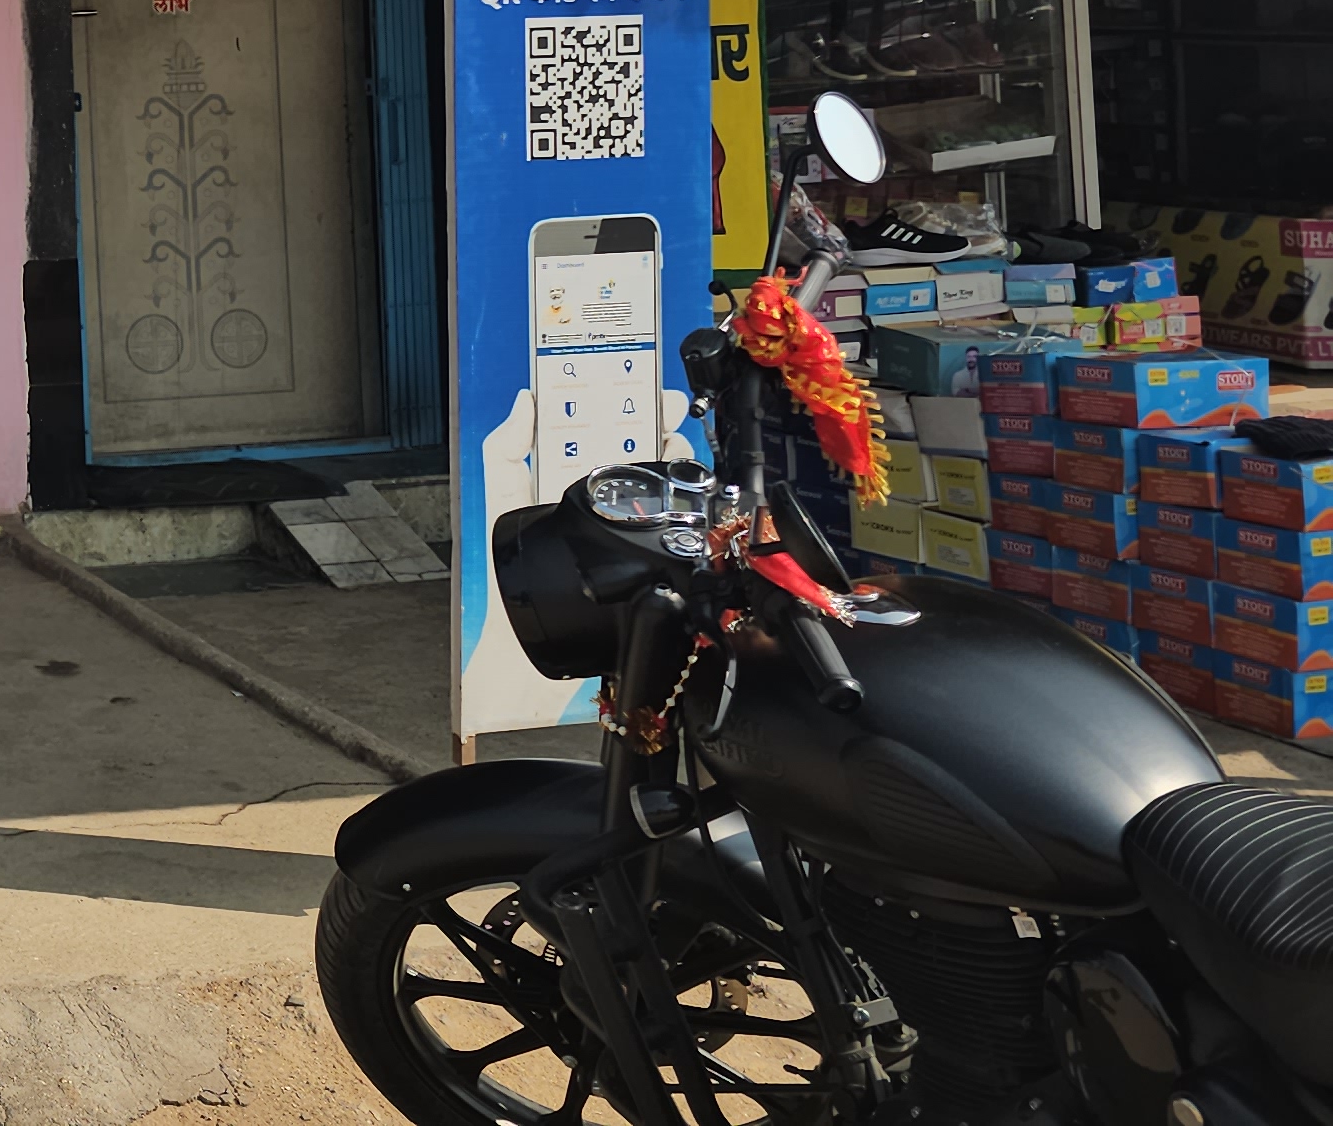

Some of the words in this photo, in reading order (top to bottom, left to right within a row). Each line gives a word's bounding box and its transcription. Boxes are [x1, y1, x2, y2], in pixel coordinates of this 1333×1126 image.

[1076, 367, 1110, 379] STOUT
[1218, 374, 1253, 386] STOUT
[1157, 446, 1188, 459] STOUT
[1242, 459, 1276, 474] STOUT
[1158, 510, 1190, 525] STOUT
[1239, 531, 1273, 547] STOUT
[1002, 540, 1032, 555] STOUT
[1151, 573, 1183, 589] STOUT
[1236, 598, 1271, 616] STOUT
[1234, 663, 1269, 681] STOUT
